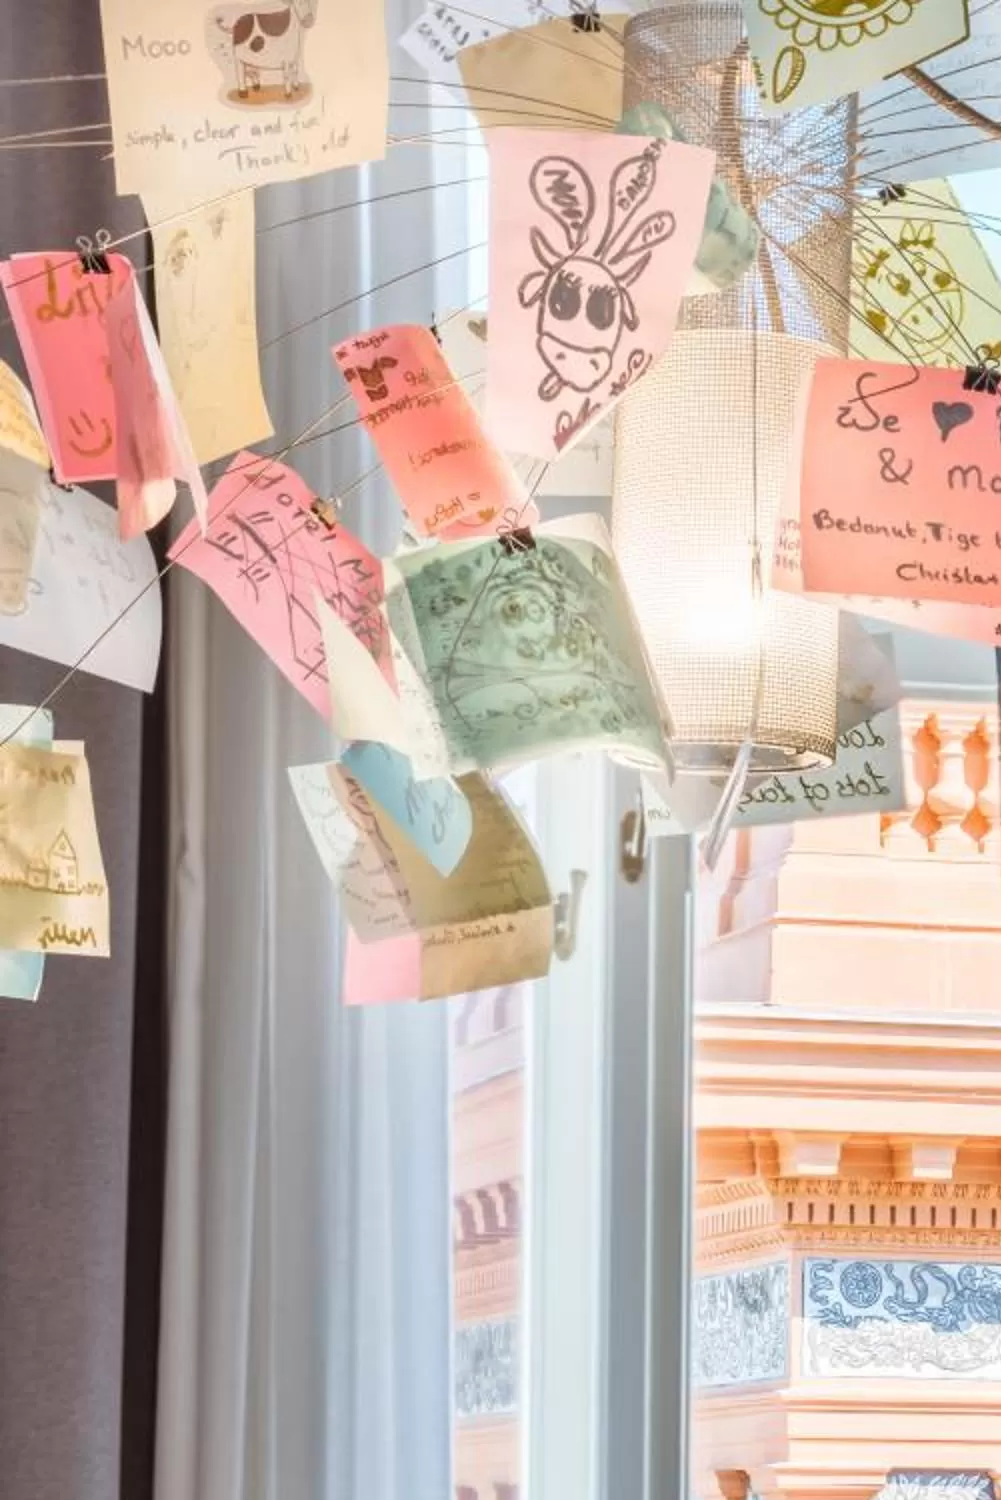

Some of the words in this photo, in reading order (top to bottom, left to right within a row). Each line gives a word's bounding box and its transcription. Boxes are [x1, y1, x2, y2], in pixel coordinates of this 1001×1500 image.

[250, 115, 283, 137] and
[835, 371, 907, 433] We
[878, 447, 914, 486] &
